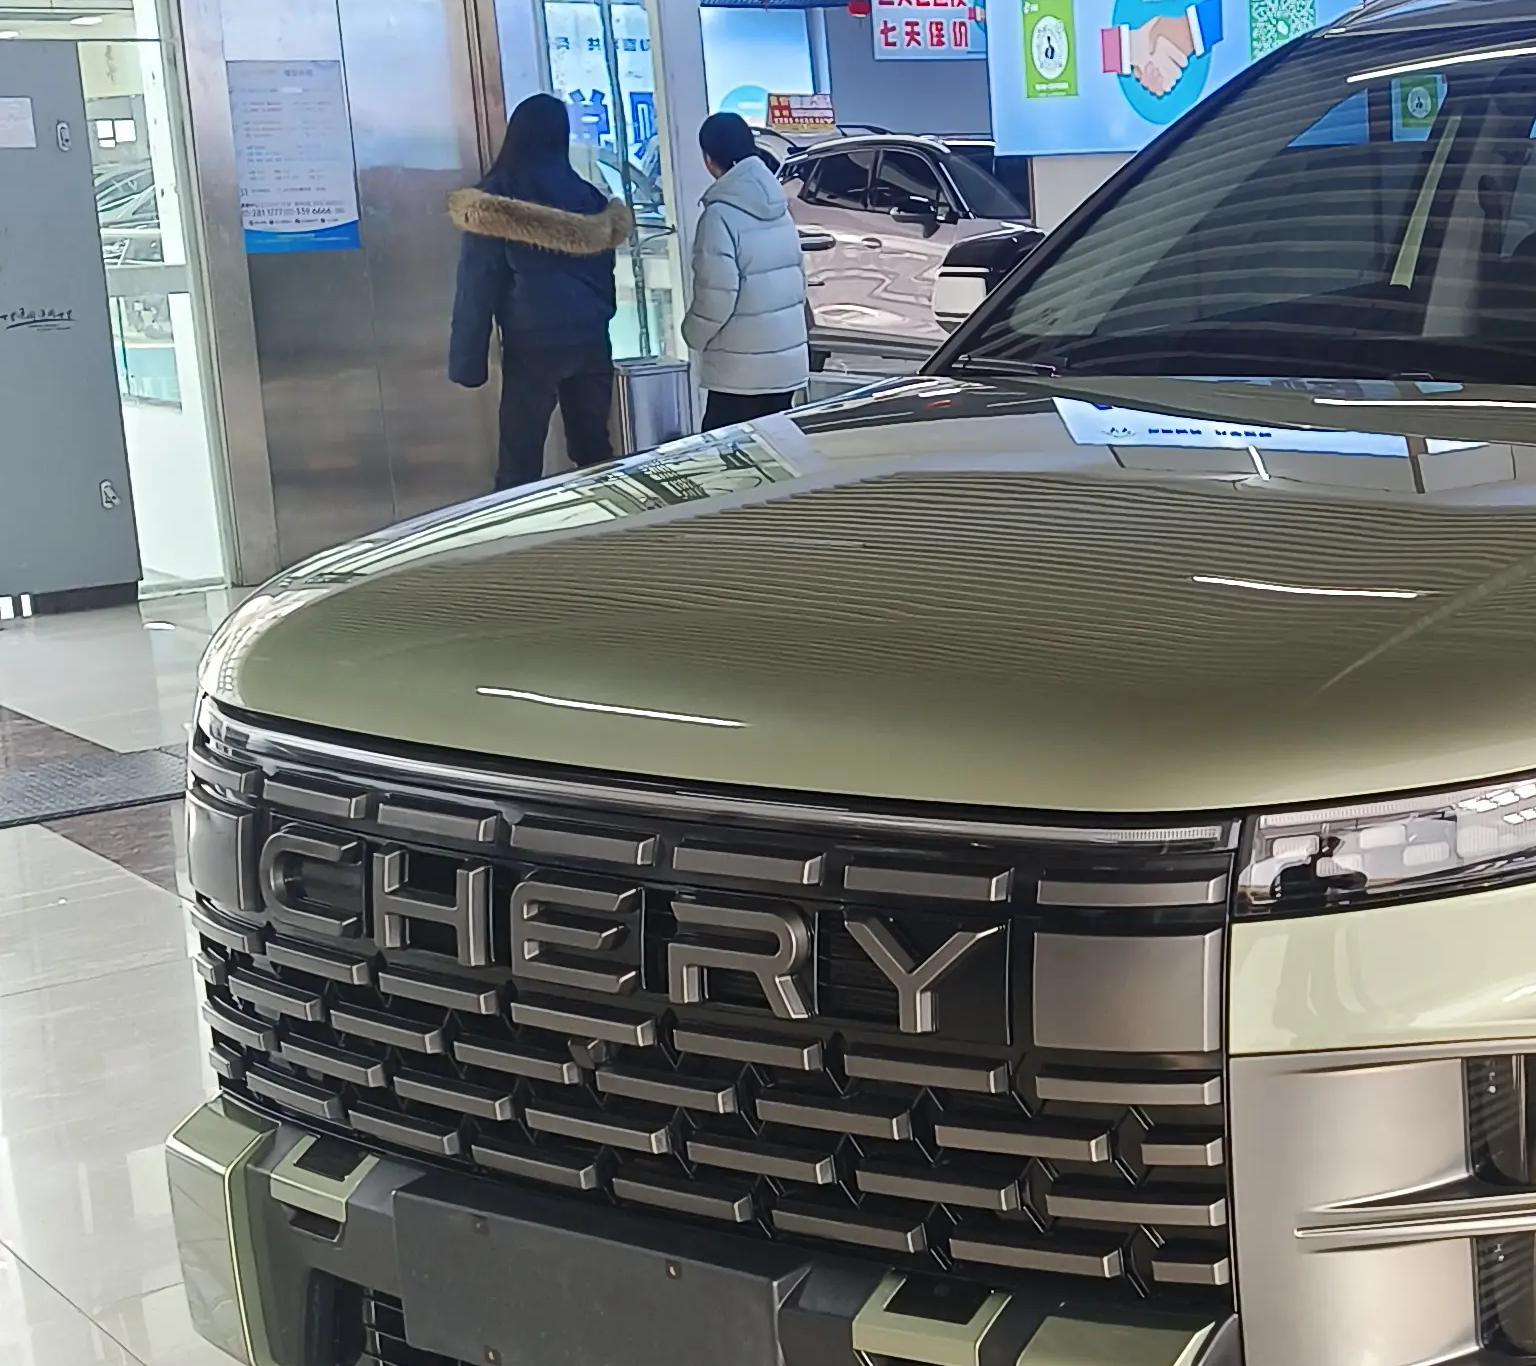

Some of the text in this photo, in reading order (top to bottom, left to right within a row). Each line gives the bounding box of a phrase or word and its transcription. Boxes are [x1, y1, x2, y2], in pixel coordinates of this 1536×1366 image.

[880, 20, 968, 47] 七天保价
[261, 822, 1005, 1034] CHERY
